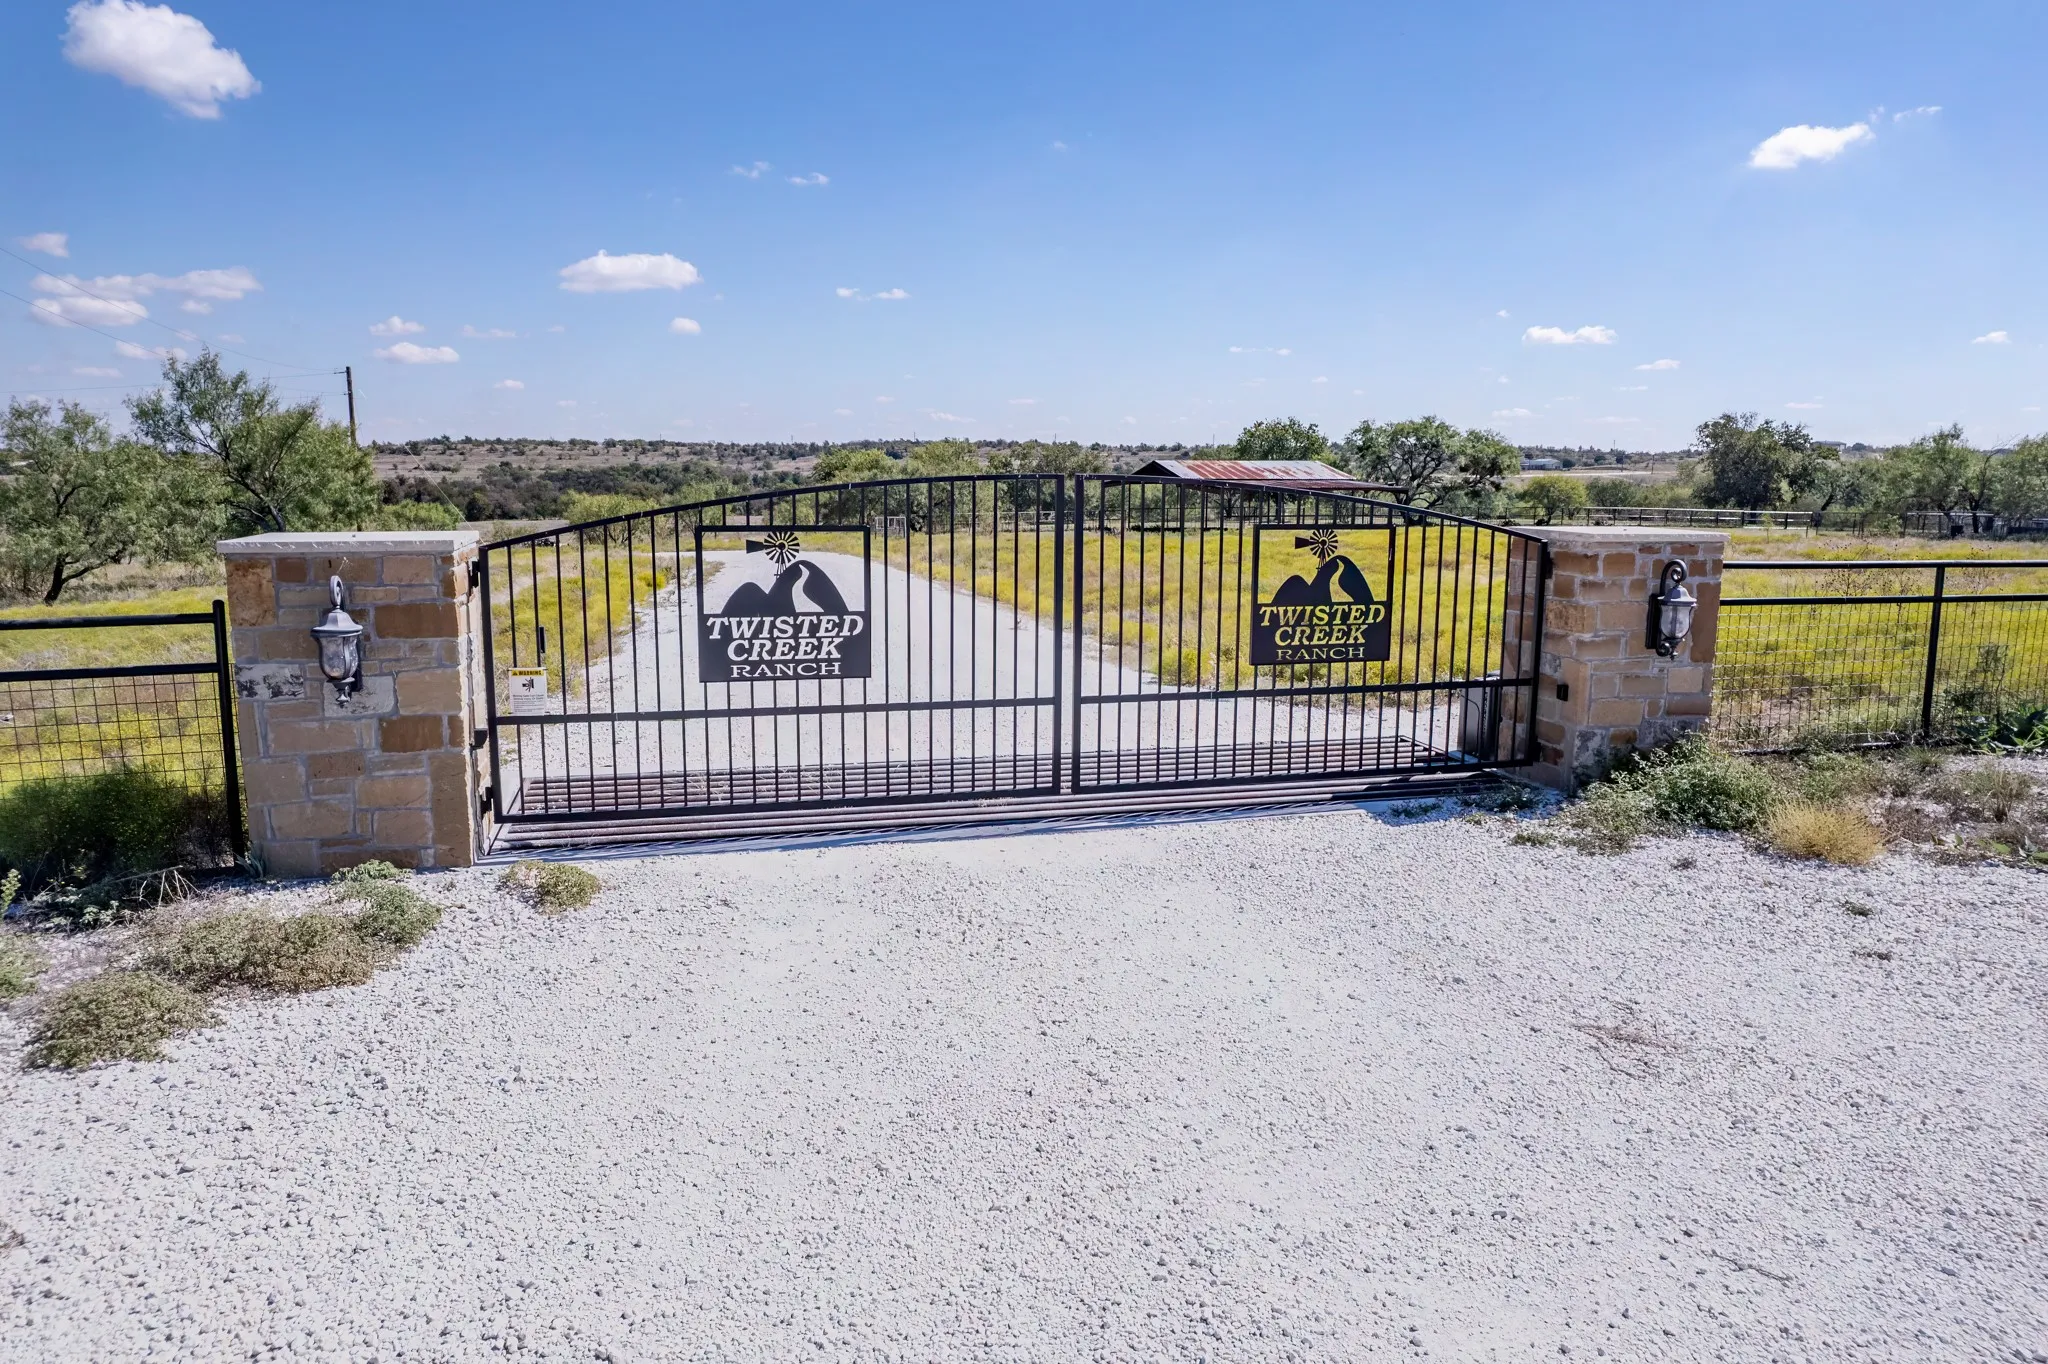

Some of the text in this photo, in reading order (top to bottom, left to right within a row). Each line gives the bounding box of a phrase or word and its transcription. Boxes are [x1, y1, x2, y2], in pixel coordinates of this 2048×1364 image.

[1259, 604, 1386, 627] TWISTED
[706, 615, 864, 639] TWISTED
[1274, 624, 1369, 646] CREEK
[727, 637, 844, 661] CREEK
[1276, 647, 1365, 661] RANCH
[730, 662, 841, 677] RANCH
